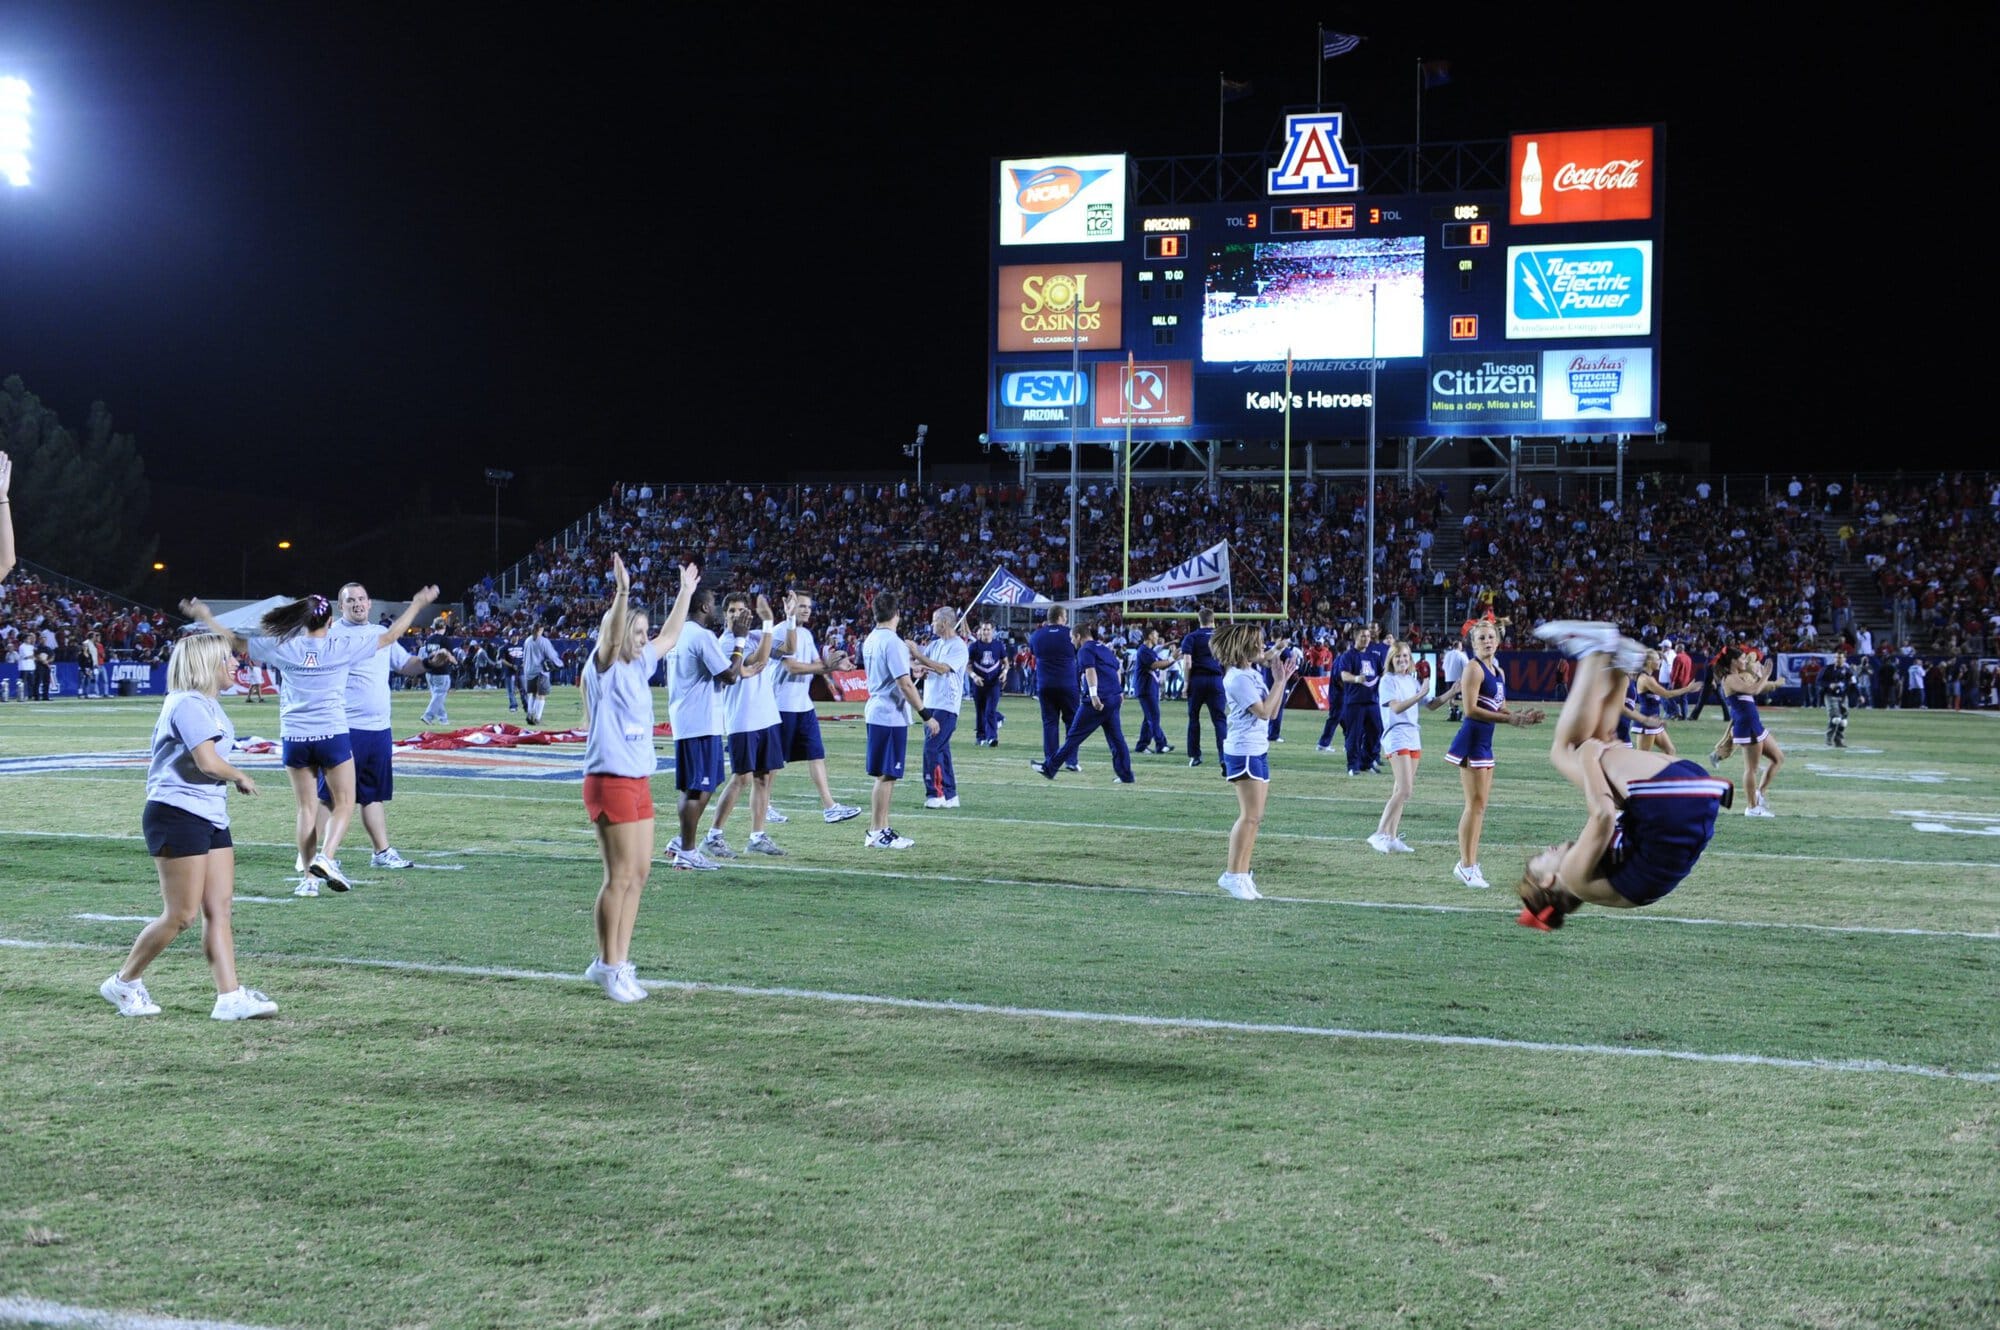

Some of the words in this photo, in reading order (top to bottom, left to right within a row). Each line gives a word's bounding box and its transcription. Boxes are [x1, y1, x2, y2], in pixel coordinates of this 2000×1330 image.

[1268, 112, 1358, 195] A
[1553, 160, 1645, 192] Coca-Cola
[1026, 184, 1071, 203] NCAA
[1226, 217, 1245, 227] TOL
[1247, 214, 1257, 228] 3
[1291, 206, 1353, 230] 7:06
[1369, 208, 1380, 223] 3
[1382, 211, 1402, 221] TOL
[1454, 205, 1479, 220] USC
[1088, 219, 1112, 232] 10
[1144, 217, 1191, 231] ARIZONA
[1470, 225, 1487, 245] 0
[1161, 237, 1177, 256] 0
[1546, 257, 1614, 276] Tucson
[1552, 274, 1632, 292] Electric
[1021, 274, 1100, 314] SOL
[1560, 292, 1630, 310] Power
[1020, 313, 1101, 332] CASINOS
[1252, 359, 1387, 373] ARIZOAATHLETICS.COM
[1482, 362, 1534, 375] Tucson
[1015, 375, 1076, 402] FSN
[1131, 374, 1156, 405] K
[1432, 369, 1536, 395] Citizen
[1246, 392, 1303, 413] Kelly's
[1307, 390, 1373, 408] Heroes
[1432, 401, 1454, 410] Miss
[1465, 401, 1485, 411] day.
[1487, 400, 1510, 409] Miss
[1520, 400, 1536, 409] lot.
[1023, 409, 1064, 422] ARIZONA
[111, 664, 151, 682] ACTION
